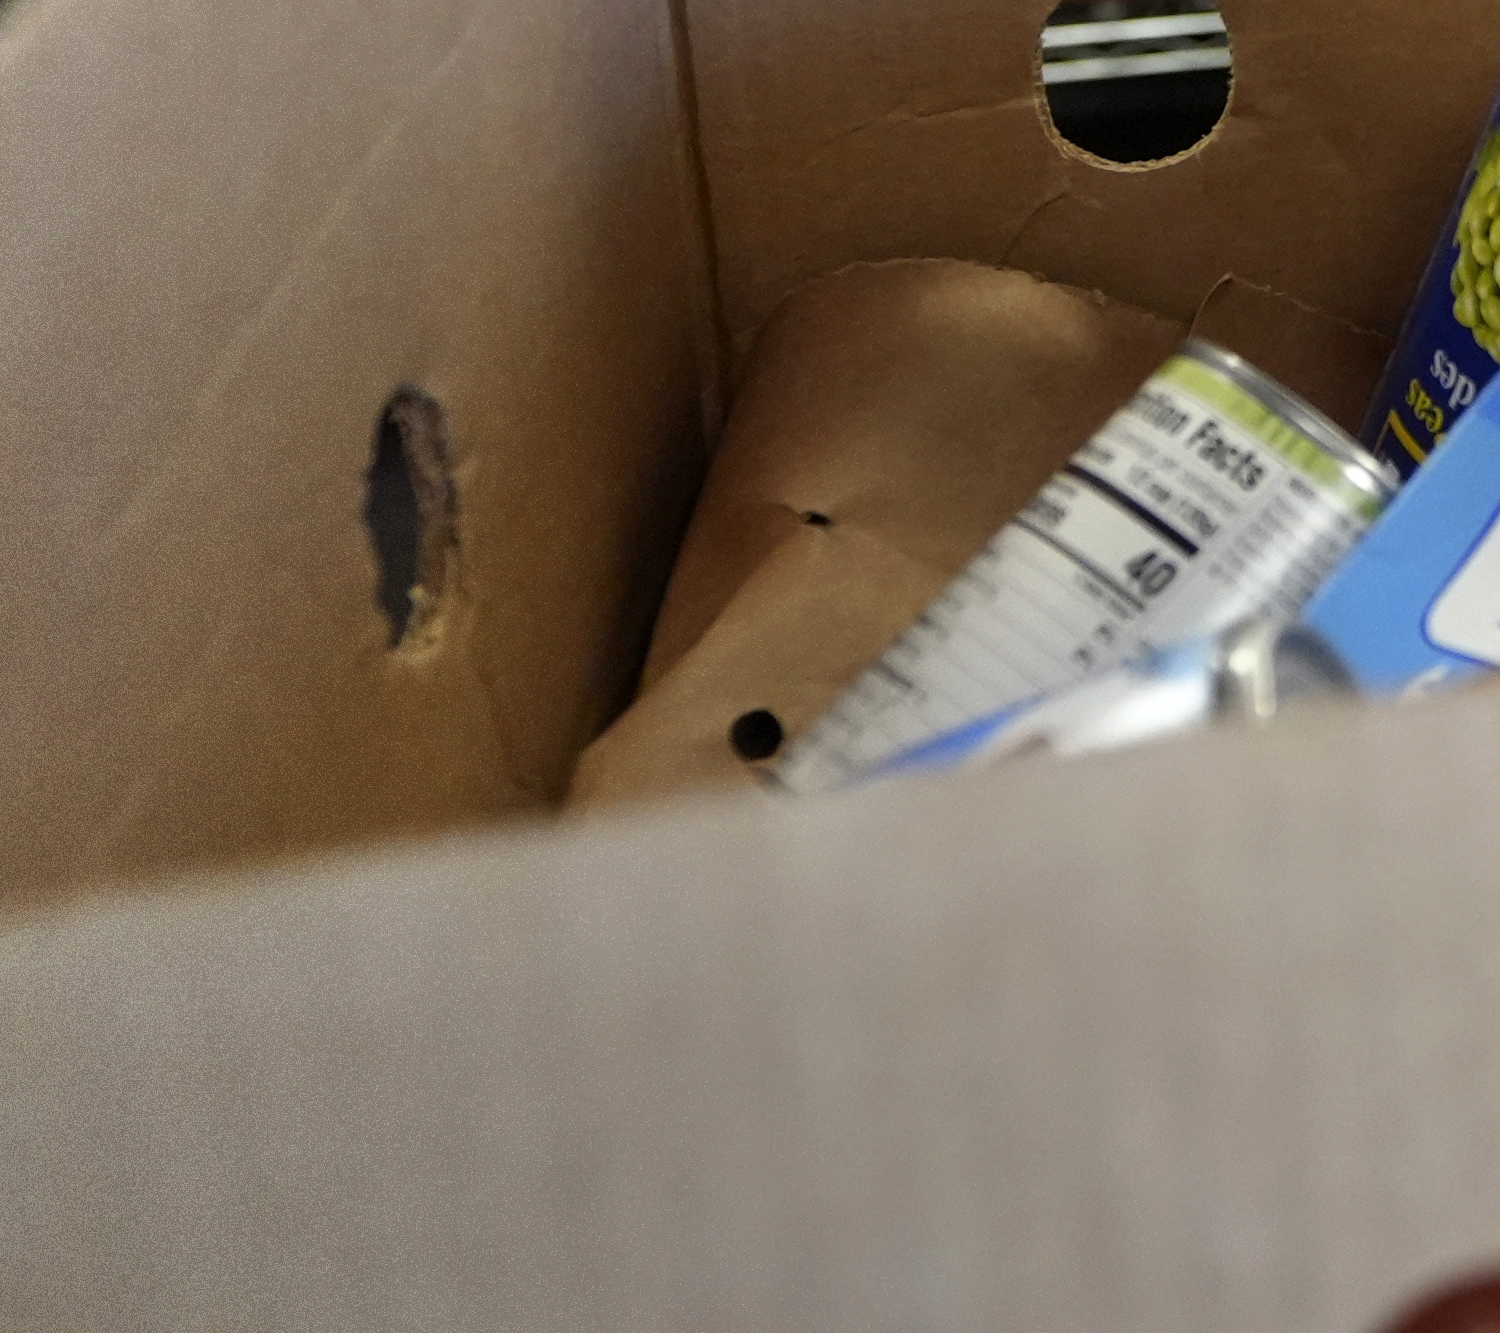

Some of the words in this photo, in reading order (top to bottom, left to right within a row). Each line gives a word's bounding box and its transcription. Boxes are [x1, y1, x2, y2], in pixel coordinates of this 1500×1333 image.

[1429, 348, 1477, 411] des
[1182, 413, 1272, 495] Facts
[1119, 541, 1181, 602] 40
